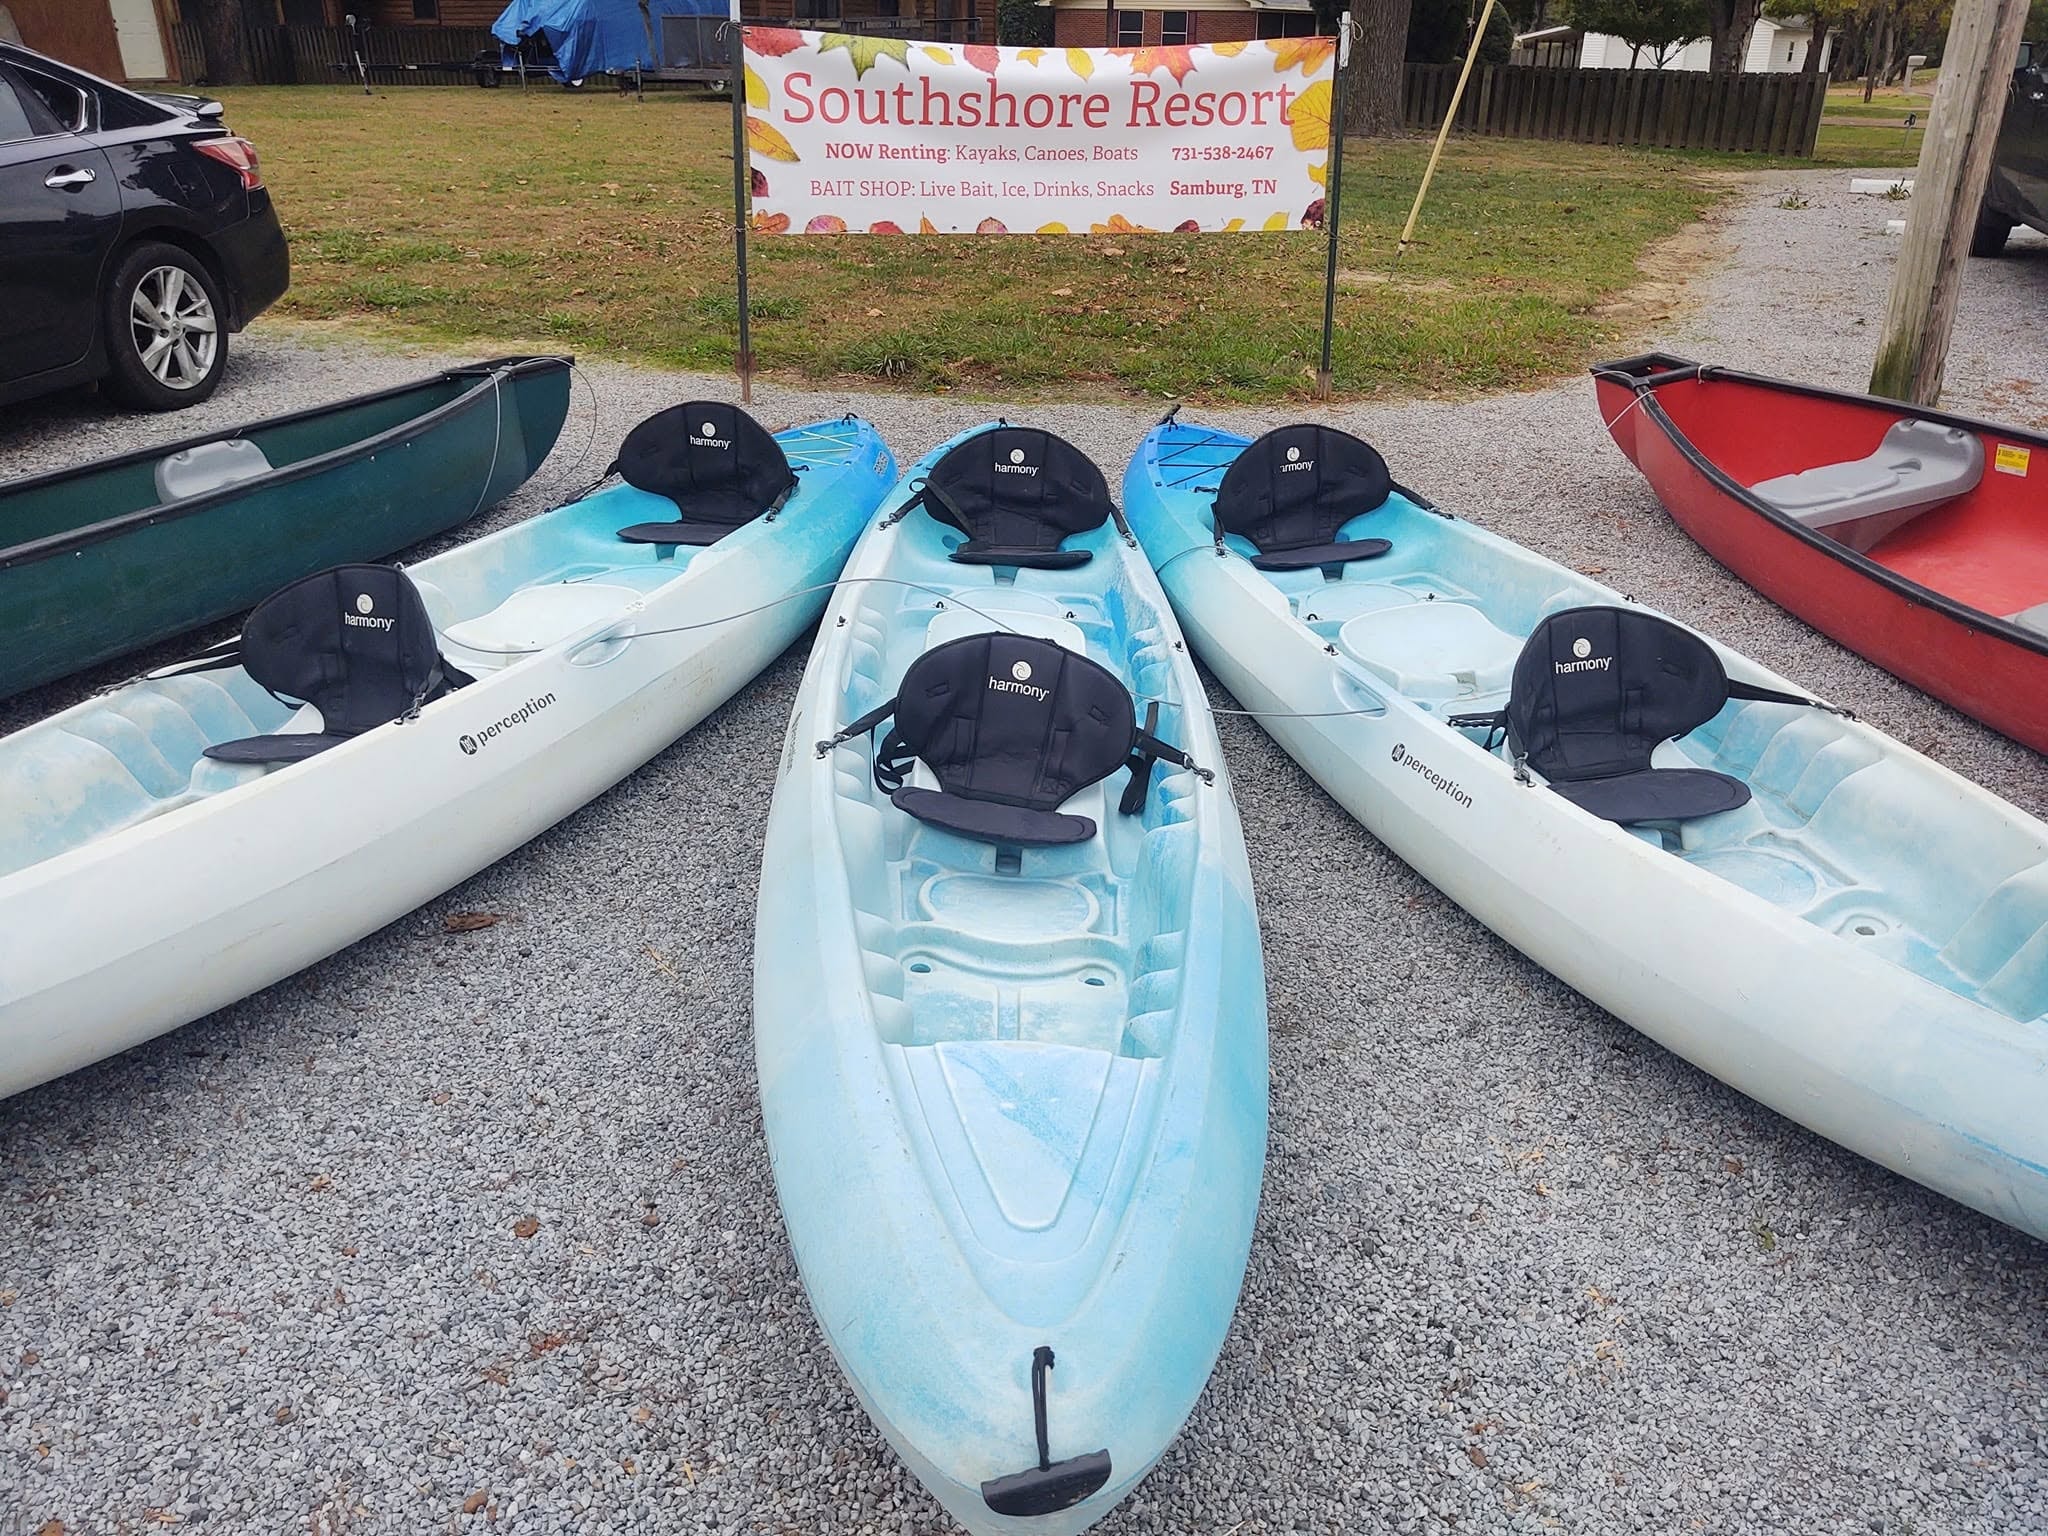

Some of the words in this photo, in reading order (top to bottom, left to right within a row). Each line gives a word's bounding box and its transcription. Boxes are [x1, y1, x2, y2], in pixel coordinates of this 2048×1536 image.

[783, 71, 1110, 129] Southshore
[1126, 80, 1296, 128] Resort
[825, 143, 874, 160] NOW
[878, 143, 951, 164] Renting:
[956, 144, 1020, 164] Kayaks,
[1024, 145, 1088, 163] Canoes,
[1092, 145, 1139, 161] Boats
[1171, 145, 1274, 161] 731-538-2467
[810, 180, 855, 197] BAIT
[859, 180, 916, 197] SHOP:
[920, 181, 956, 197] Live
[960, 181, 998, 199] Bait,
[1002, 181, 1030, 199] Ice,
[1034, 181, 1093, 198] Drinks,
[1096, 181, 1155, 197] Snacks
[1169, 180, 1248, 199] Samburg,
[1252, 179, 1278, 195] TN
[689, 434, 732, 450] harmony
[994, 461, 1039, 477] harmony
[344, 611, 395, 632] harmony
[1555, 656, 1612, 674] harmony
[988, 675, 1050, 702] harmony
[476, 692, 556, 747] perception
[1402, 754, 1473, 808] perception
